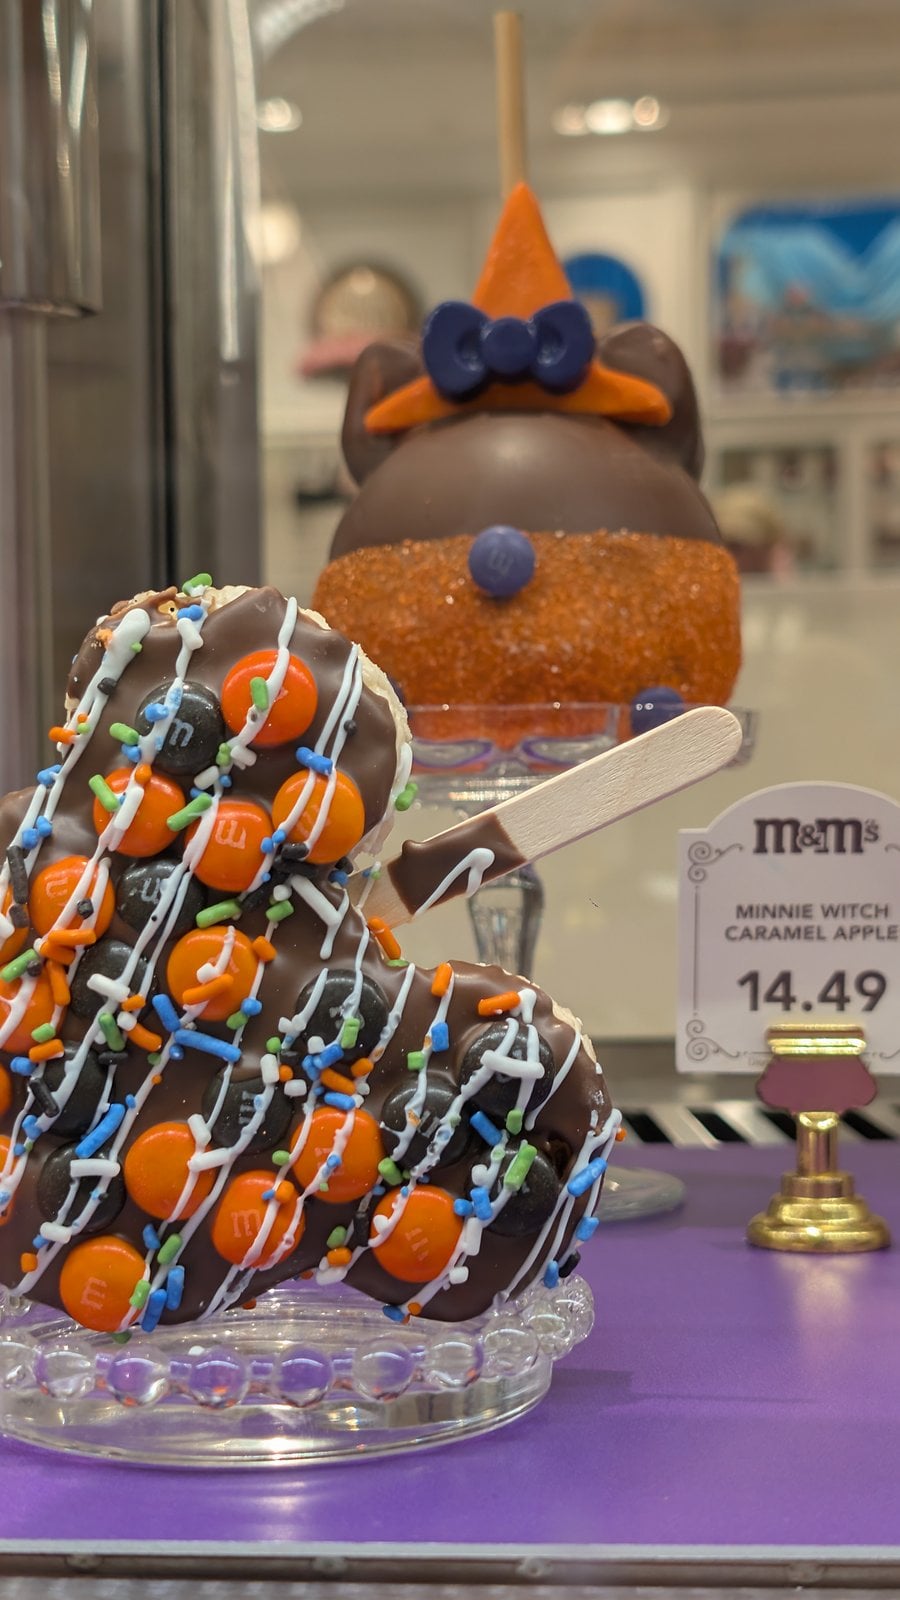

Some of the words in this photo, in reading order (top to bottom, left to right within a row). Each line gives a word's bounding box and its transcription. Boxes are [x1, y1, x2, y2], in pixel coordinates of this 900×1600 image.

[215, 819, 246, 849] m
[736, 904, 813, 919] MINNIE
[821, 904, 889, 919] WITCH
[725, 926, 826, 941] CARAMEL
[833, 926, 898, 941] APPLE
[738, 970, 886, 1012] 14.49
[231, 1209, 261, 1238] m
